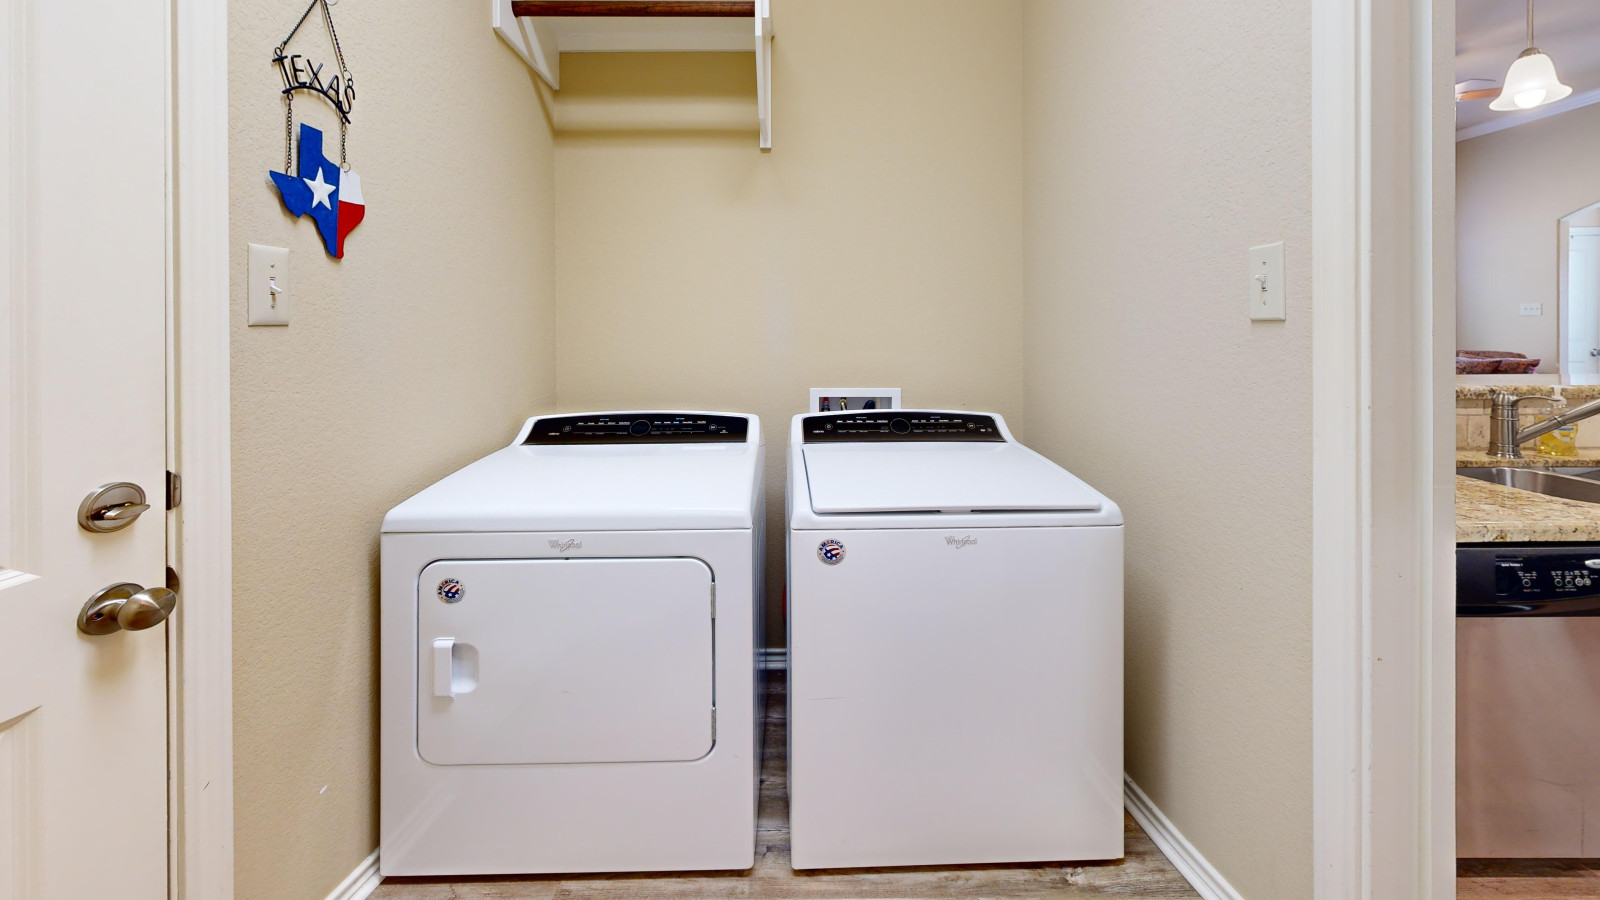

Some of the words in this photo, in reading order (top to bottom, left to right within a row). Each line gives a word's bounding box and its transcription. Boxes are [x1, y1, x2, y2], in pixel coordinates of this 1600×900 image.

[272, 55, 356, 115] TEXAS
[818, 539, 844, 552] AMERICA
[437, 578, 460, 596] AMERICA
